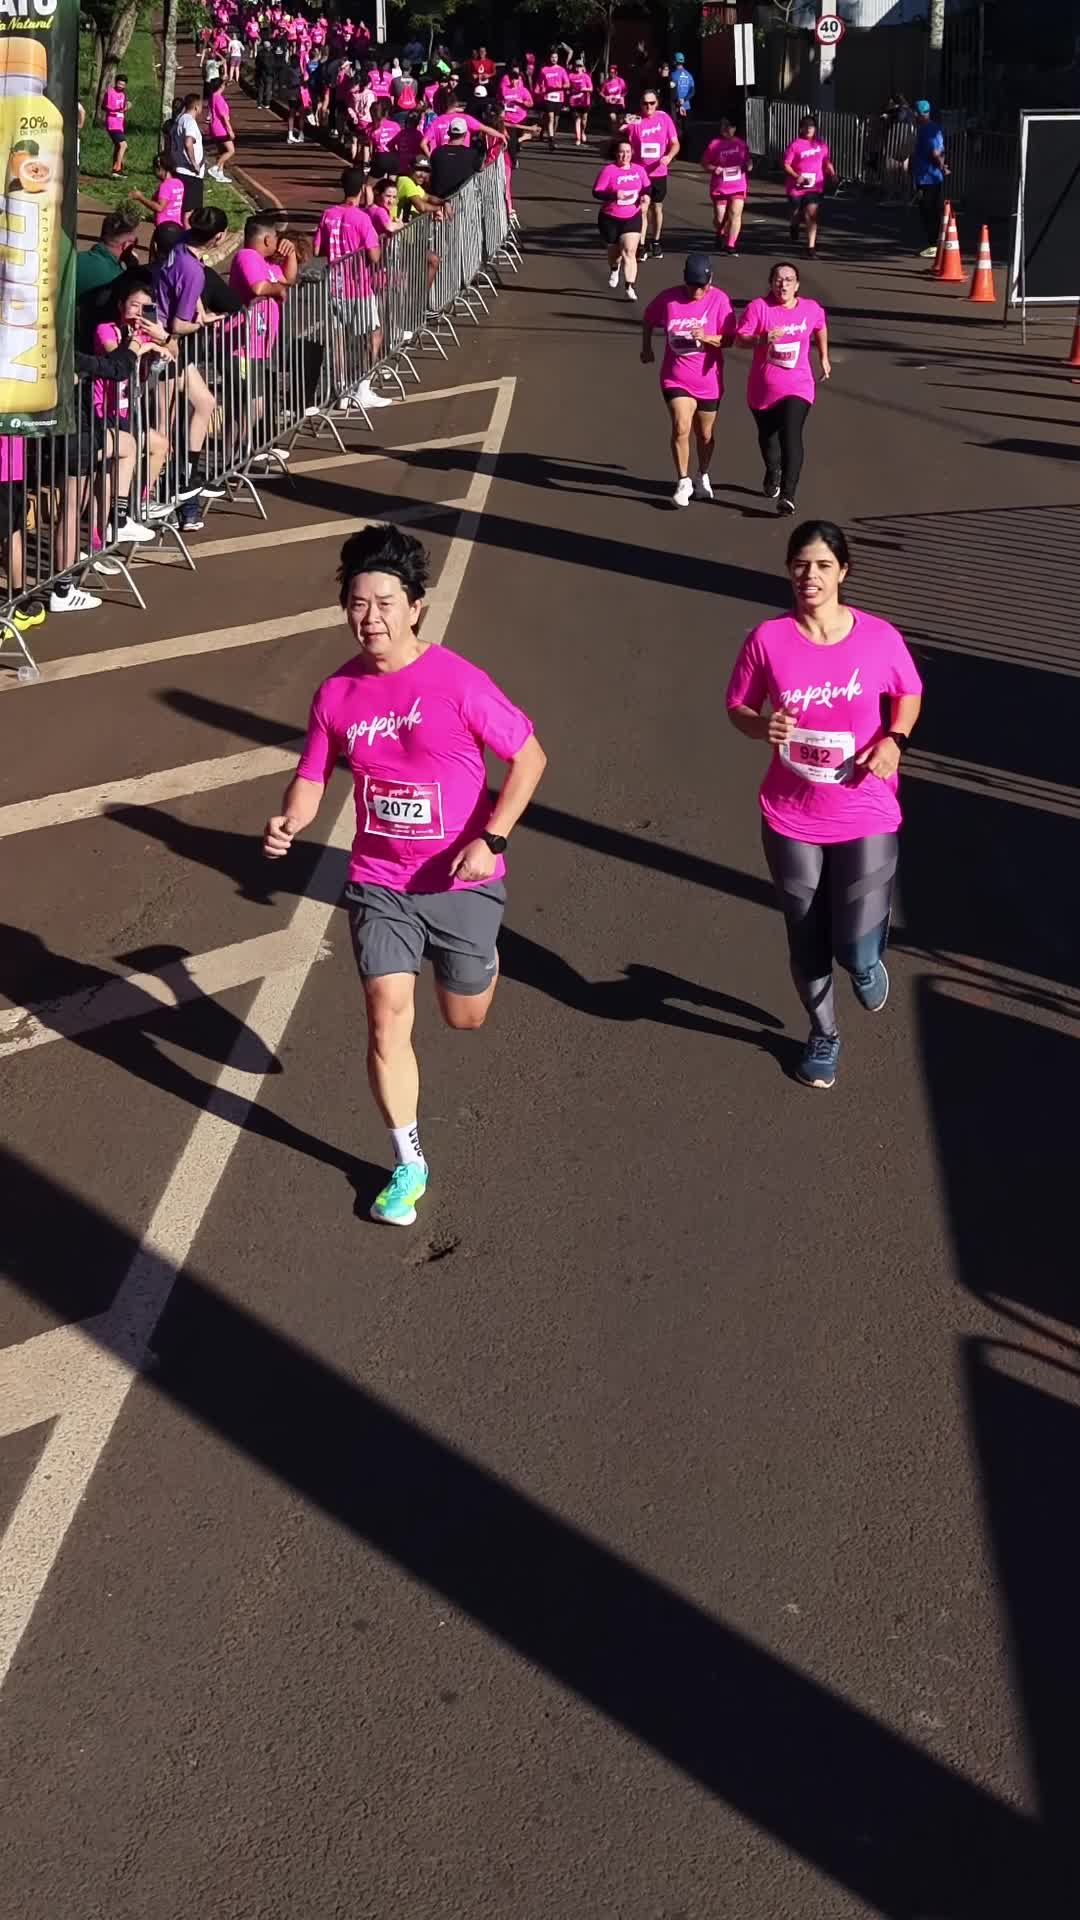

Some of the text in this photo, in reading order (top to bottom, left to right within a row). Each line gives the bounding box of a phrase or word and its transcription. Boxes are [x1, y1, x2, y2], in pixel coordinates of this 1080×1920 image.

[8, 15, 54, 30] Natural
[820, 21, 838, 32] 40
[20, 116, 48, 130] 20%
[346, 697, 422, 755] gopink
[799, 747, 831, 763] 942
[380, 800, 423, 817] 2072
